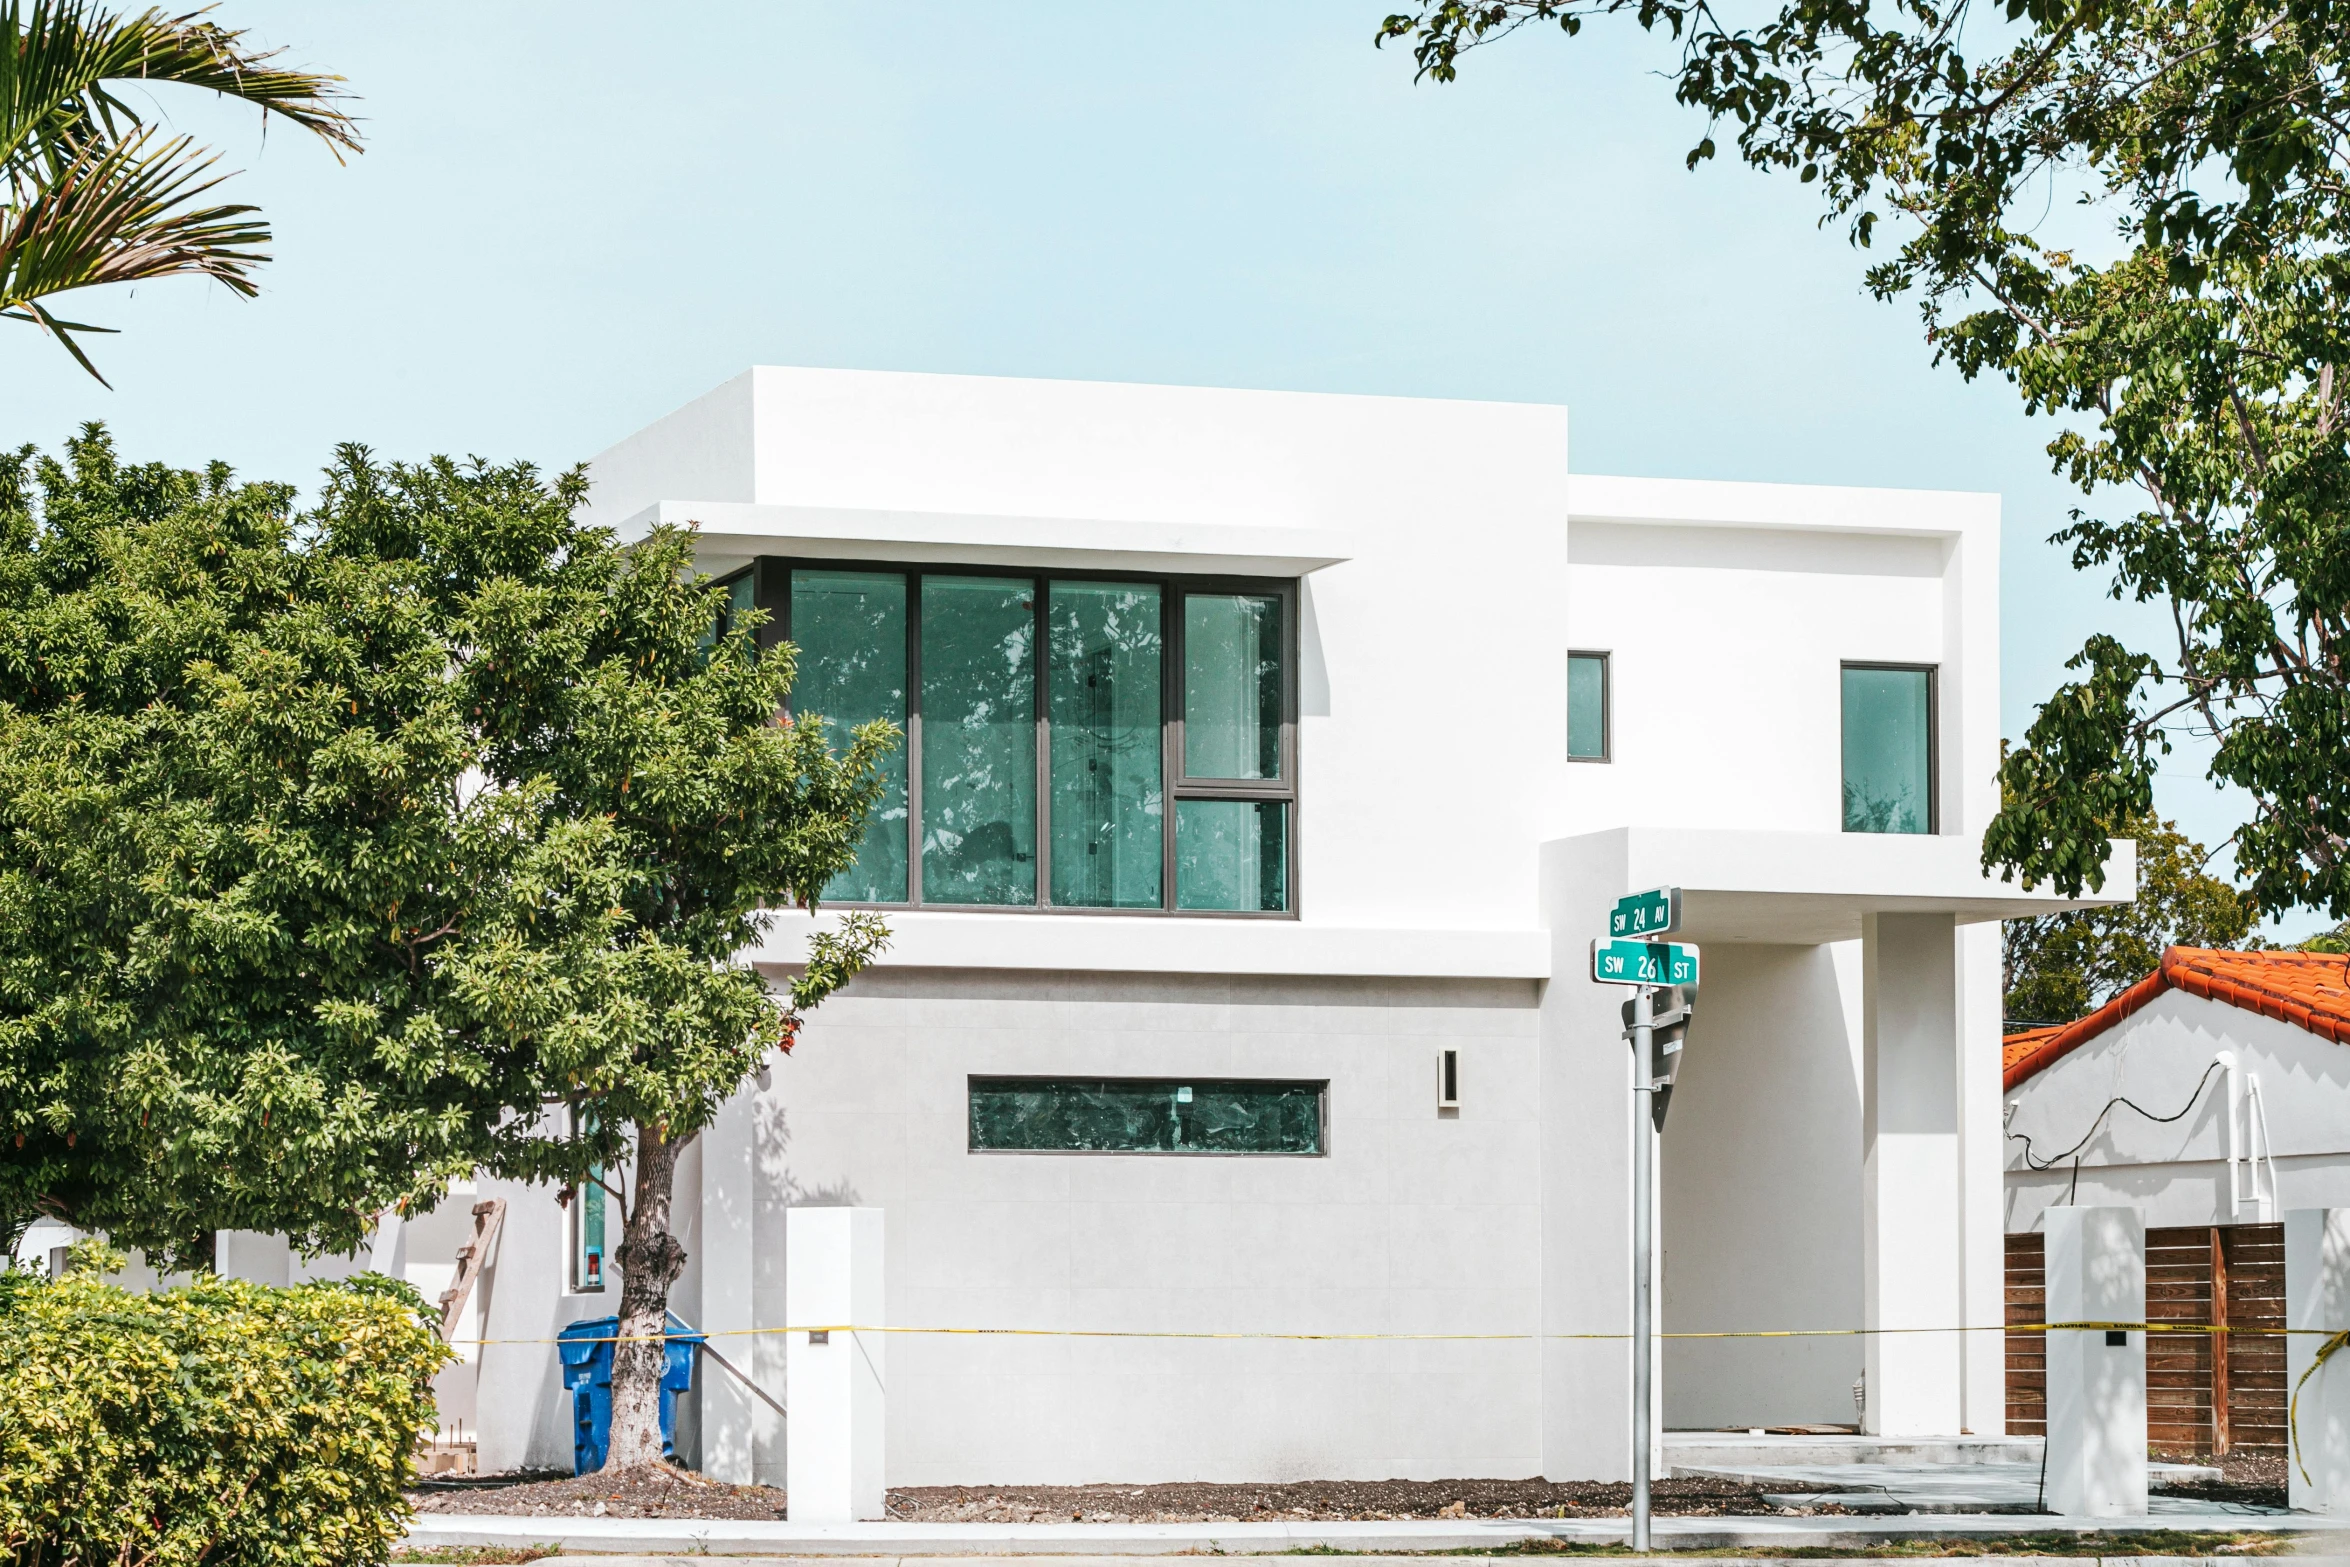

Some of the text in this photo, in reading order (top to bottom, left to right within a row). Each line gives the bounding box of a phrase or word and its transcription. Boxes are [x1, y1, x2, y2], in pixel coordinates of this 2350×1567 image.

[1614, 905, 1665, 932] SW 24 AV
[1604, 955, 1690, 979] SW 26 ST
